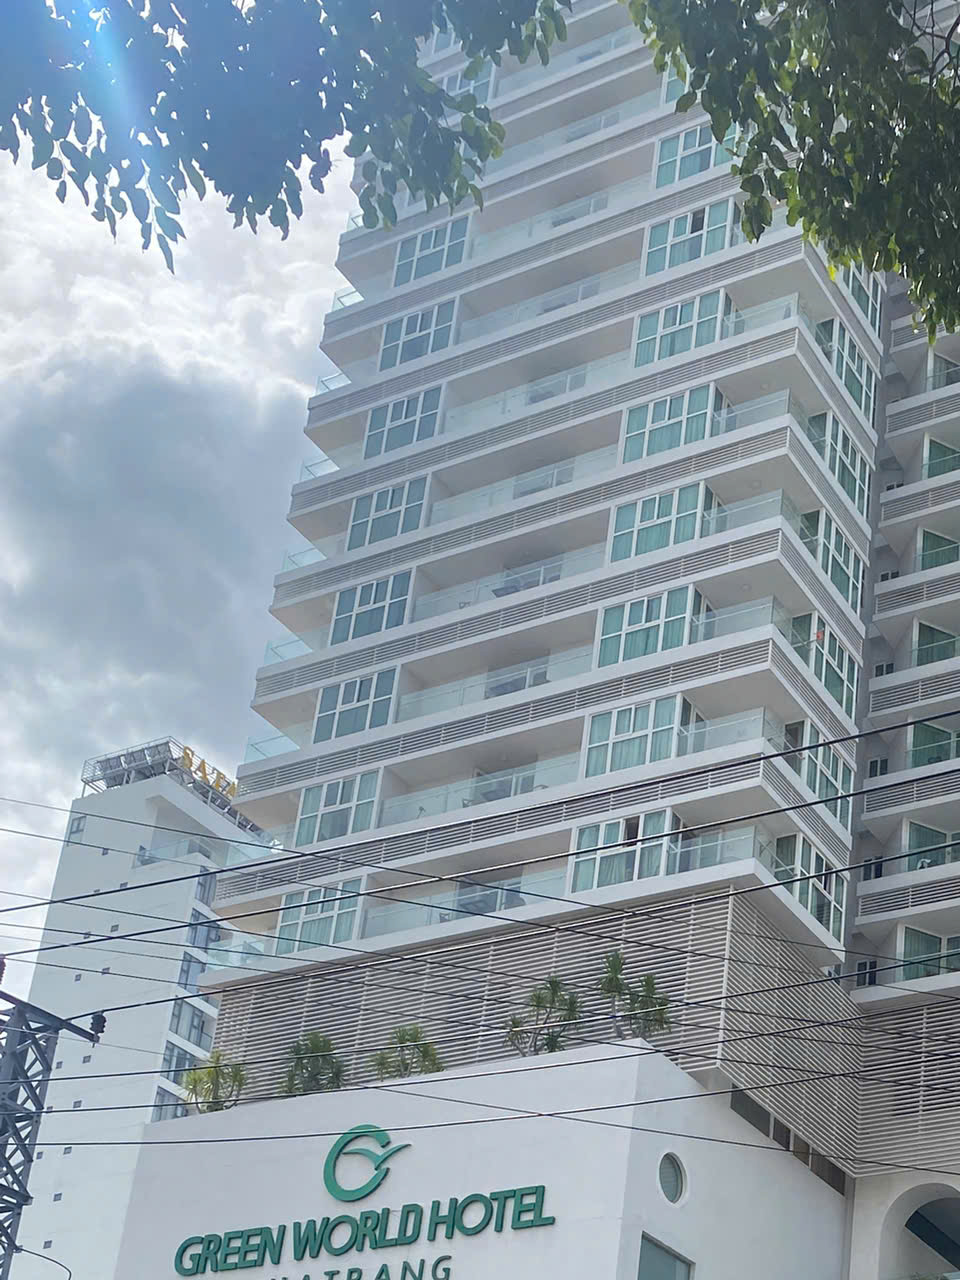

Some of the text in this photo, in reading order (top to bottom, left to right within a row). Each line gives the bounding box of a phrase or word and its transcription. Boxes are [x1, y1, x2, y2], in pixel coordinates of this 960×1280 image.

[174, 1185, 555, 1277] GREEN WORLD HOTEL
